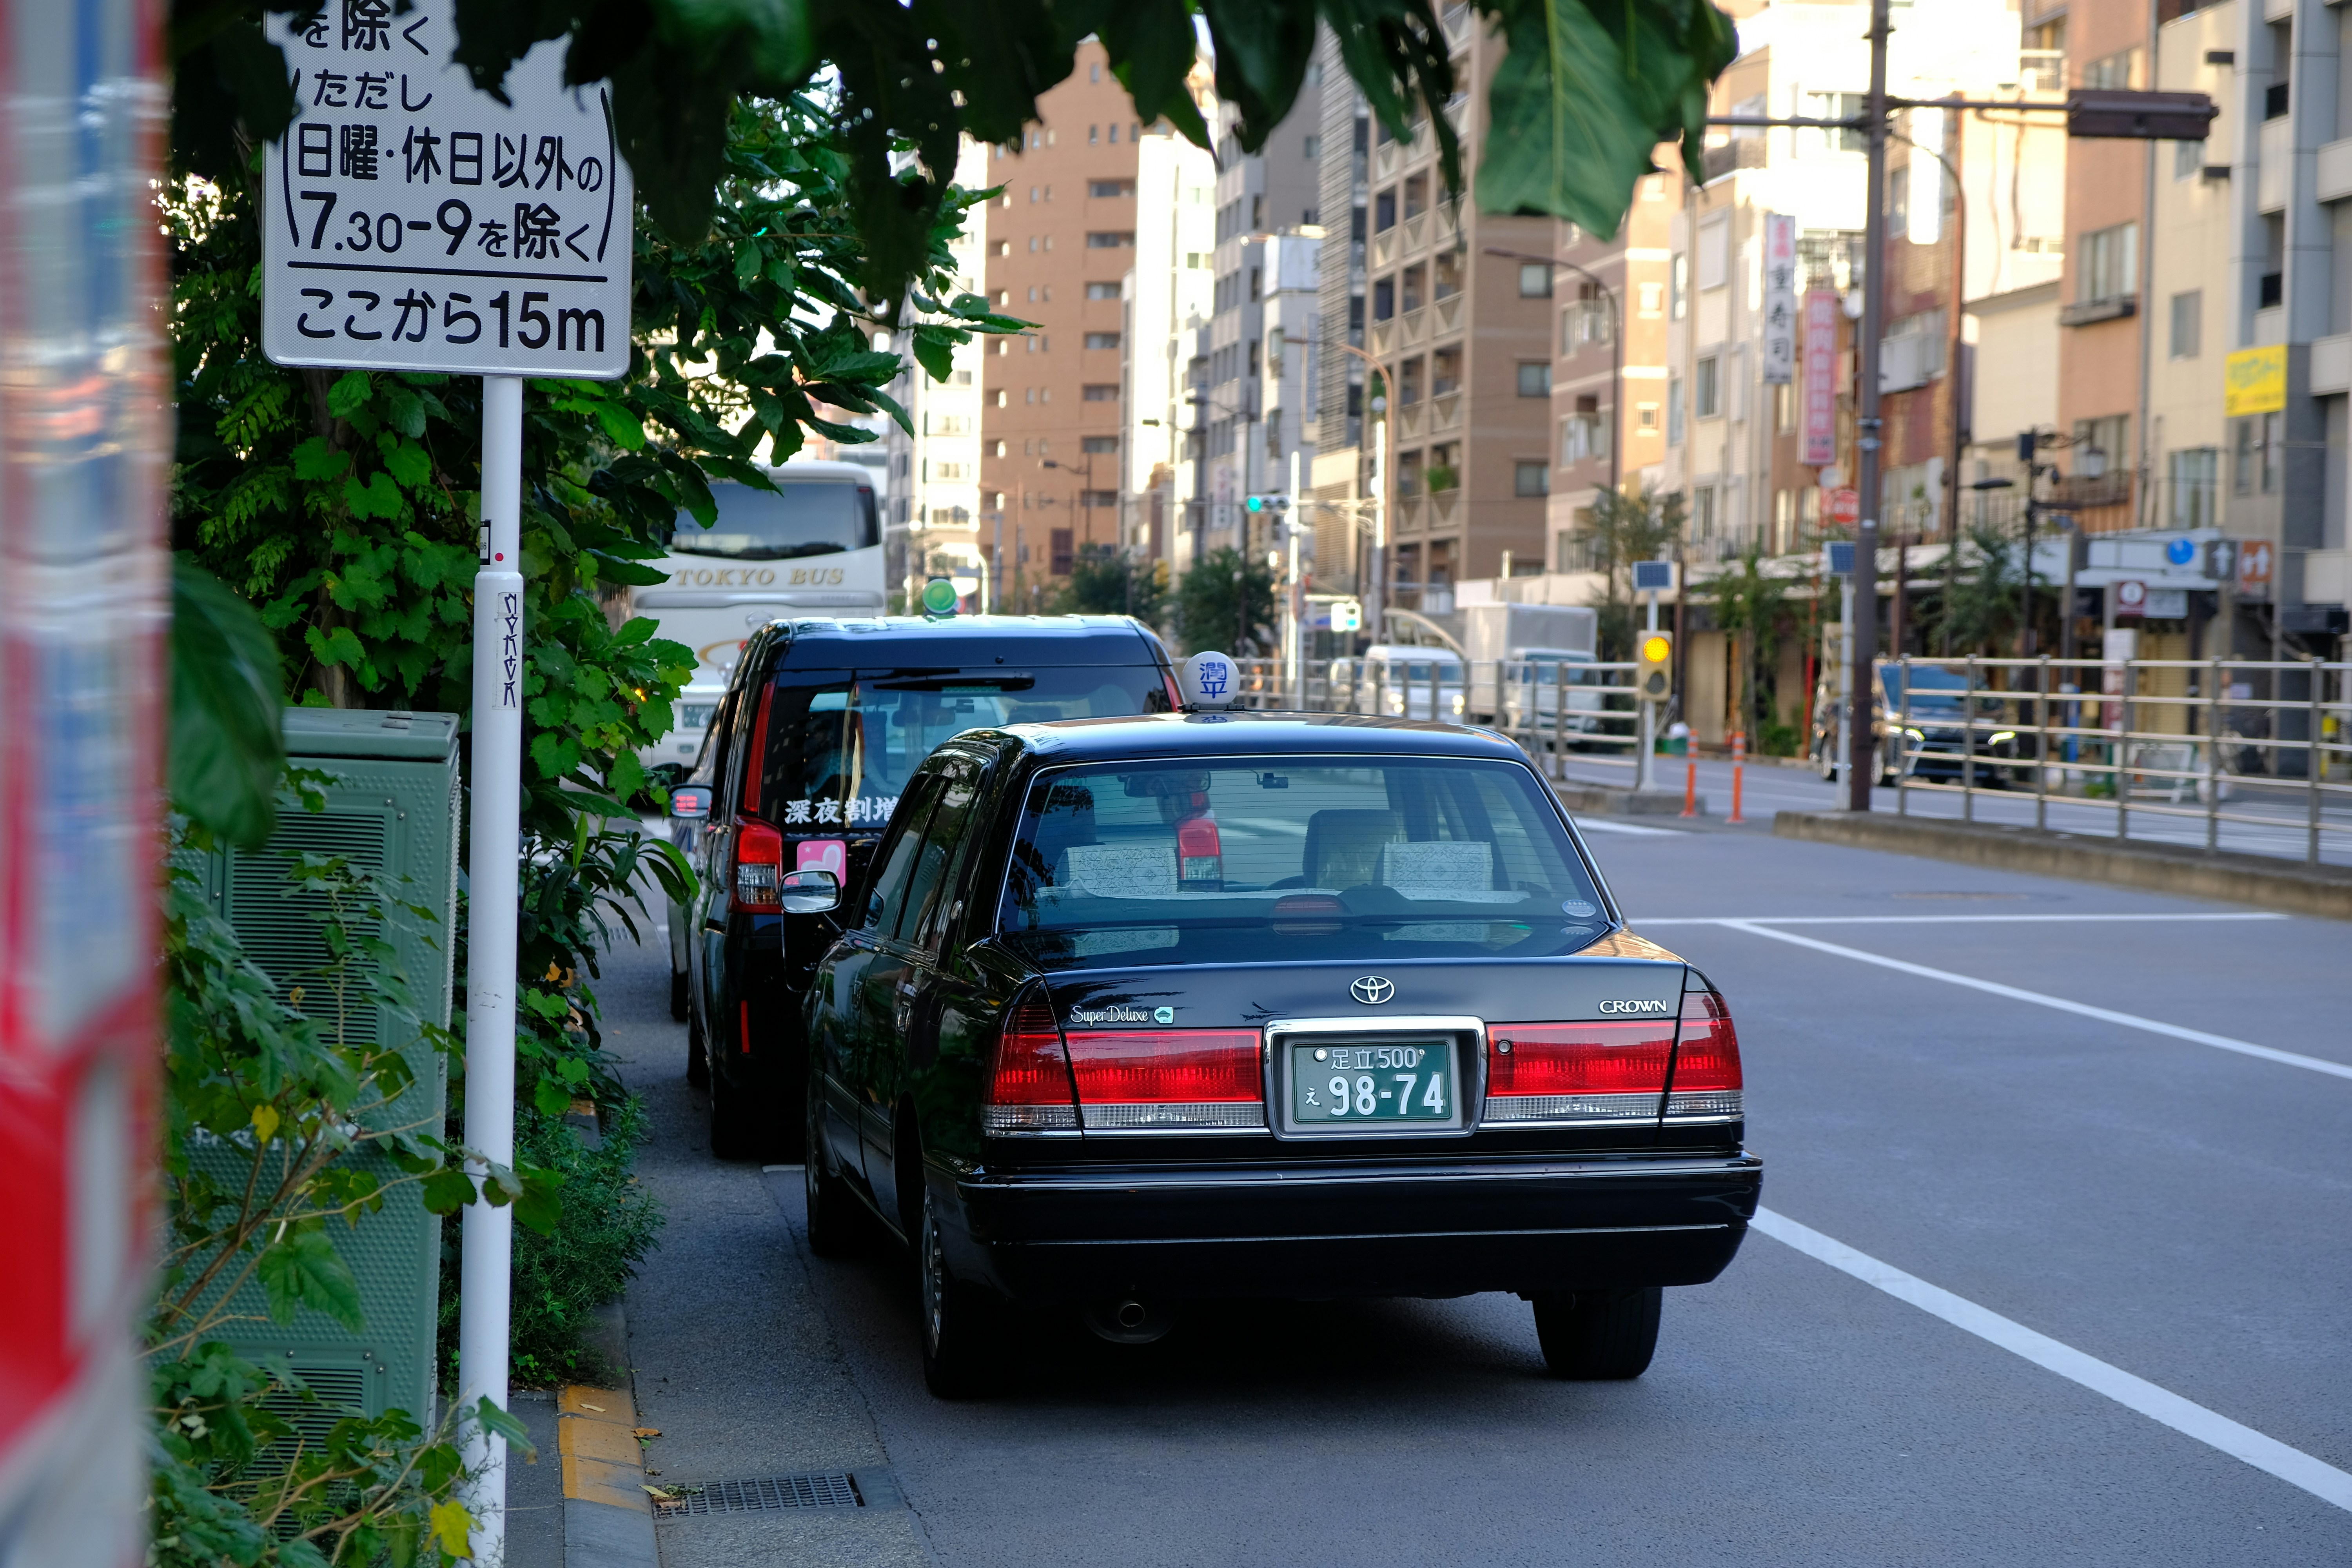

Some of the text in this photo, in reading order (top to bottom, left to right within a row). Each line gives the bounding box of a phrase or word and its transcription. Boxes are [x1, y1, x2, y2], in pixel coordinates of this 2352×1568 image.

[313, 69, 432, 111] ただし
[676, 567, 845, 586] TOKYO BUS
[1070, 1005, 1149, 1027] Super Deluxe
[1599, 999, 1667, 1014] CROWN
[1328, 1074, 1444, 1116] 98-74
